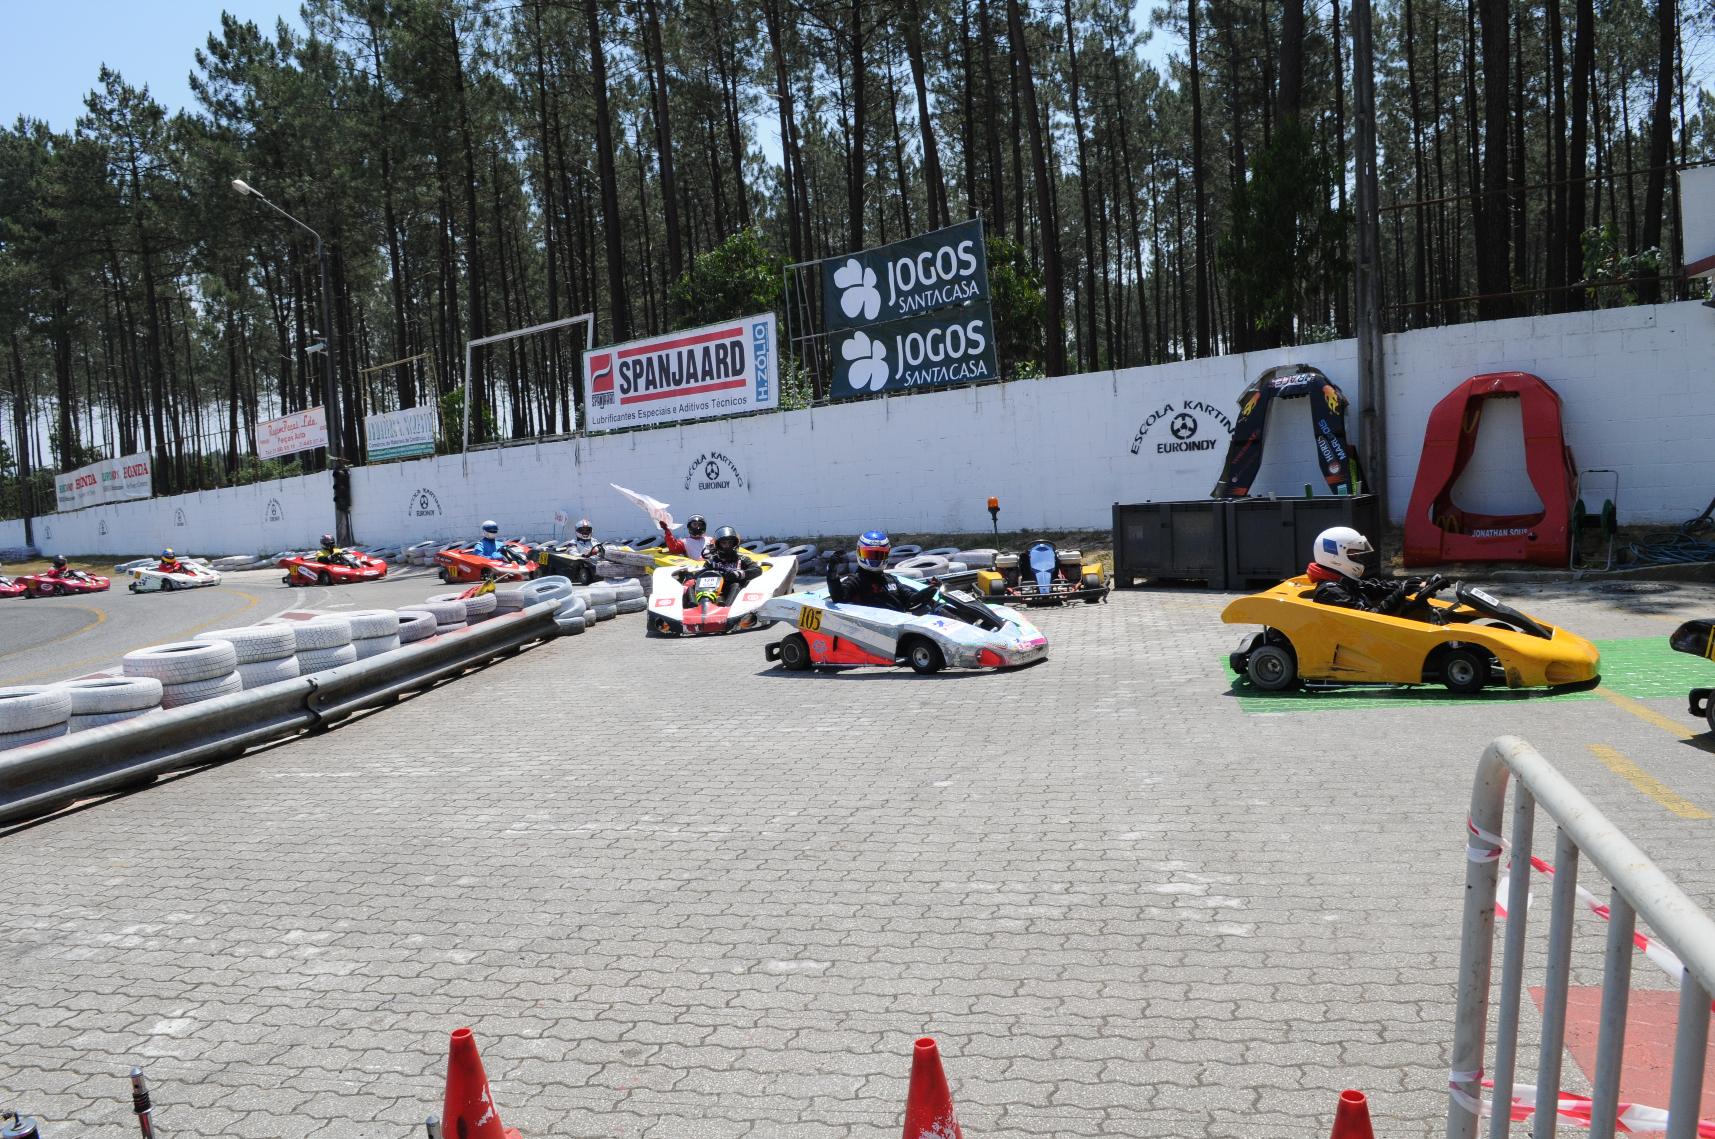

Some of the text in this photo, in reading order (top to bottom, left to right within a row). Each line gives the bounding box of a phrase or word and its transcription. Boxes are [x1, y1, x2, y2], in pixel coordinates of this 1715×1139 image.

[887, 240, 977, 307] JOGOS
[619, 339, 746, 395] SPANJAARD
[895, 319, 986, 380] JOGOS
[592, 397, 747, 425] Lubrificantes Especiais e Aditivos Técnicos
[1131, 400, 1236, 455] ESCOLA KARTIN
[1157, 440, 1217, 454] EUROINDY
[711, 451, 744, 488] KARTING
[1472, 528, 1508, 538] JONATHAN
[800, 606, 822, 631] 105
